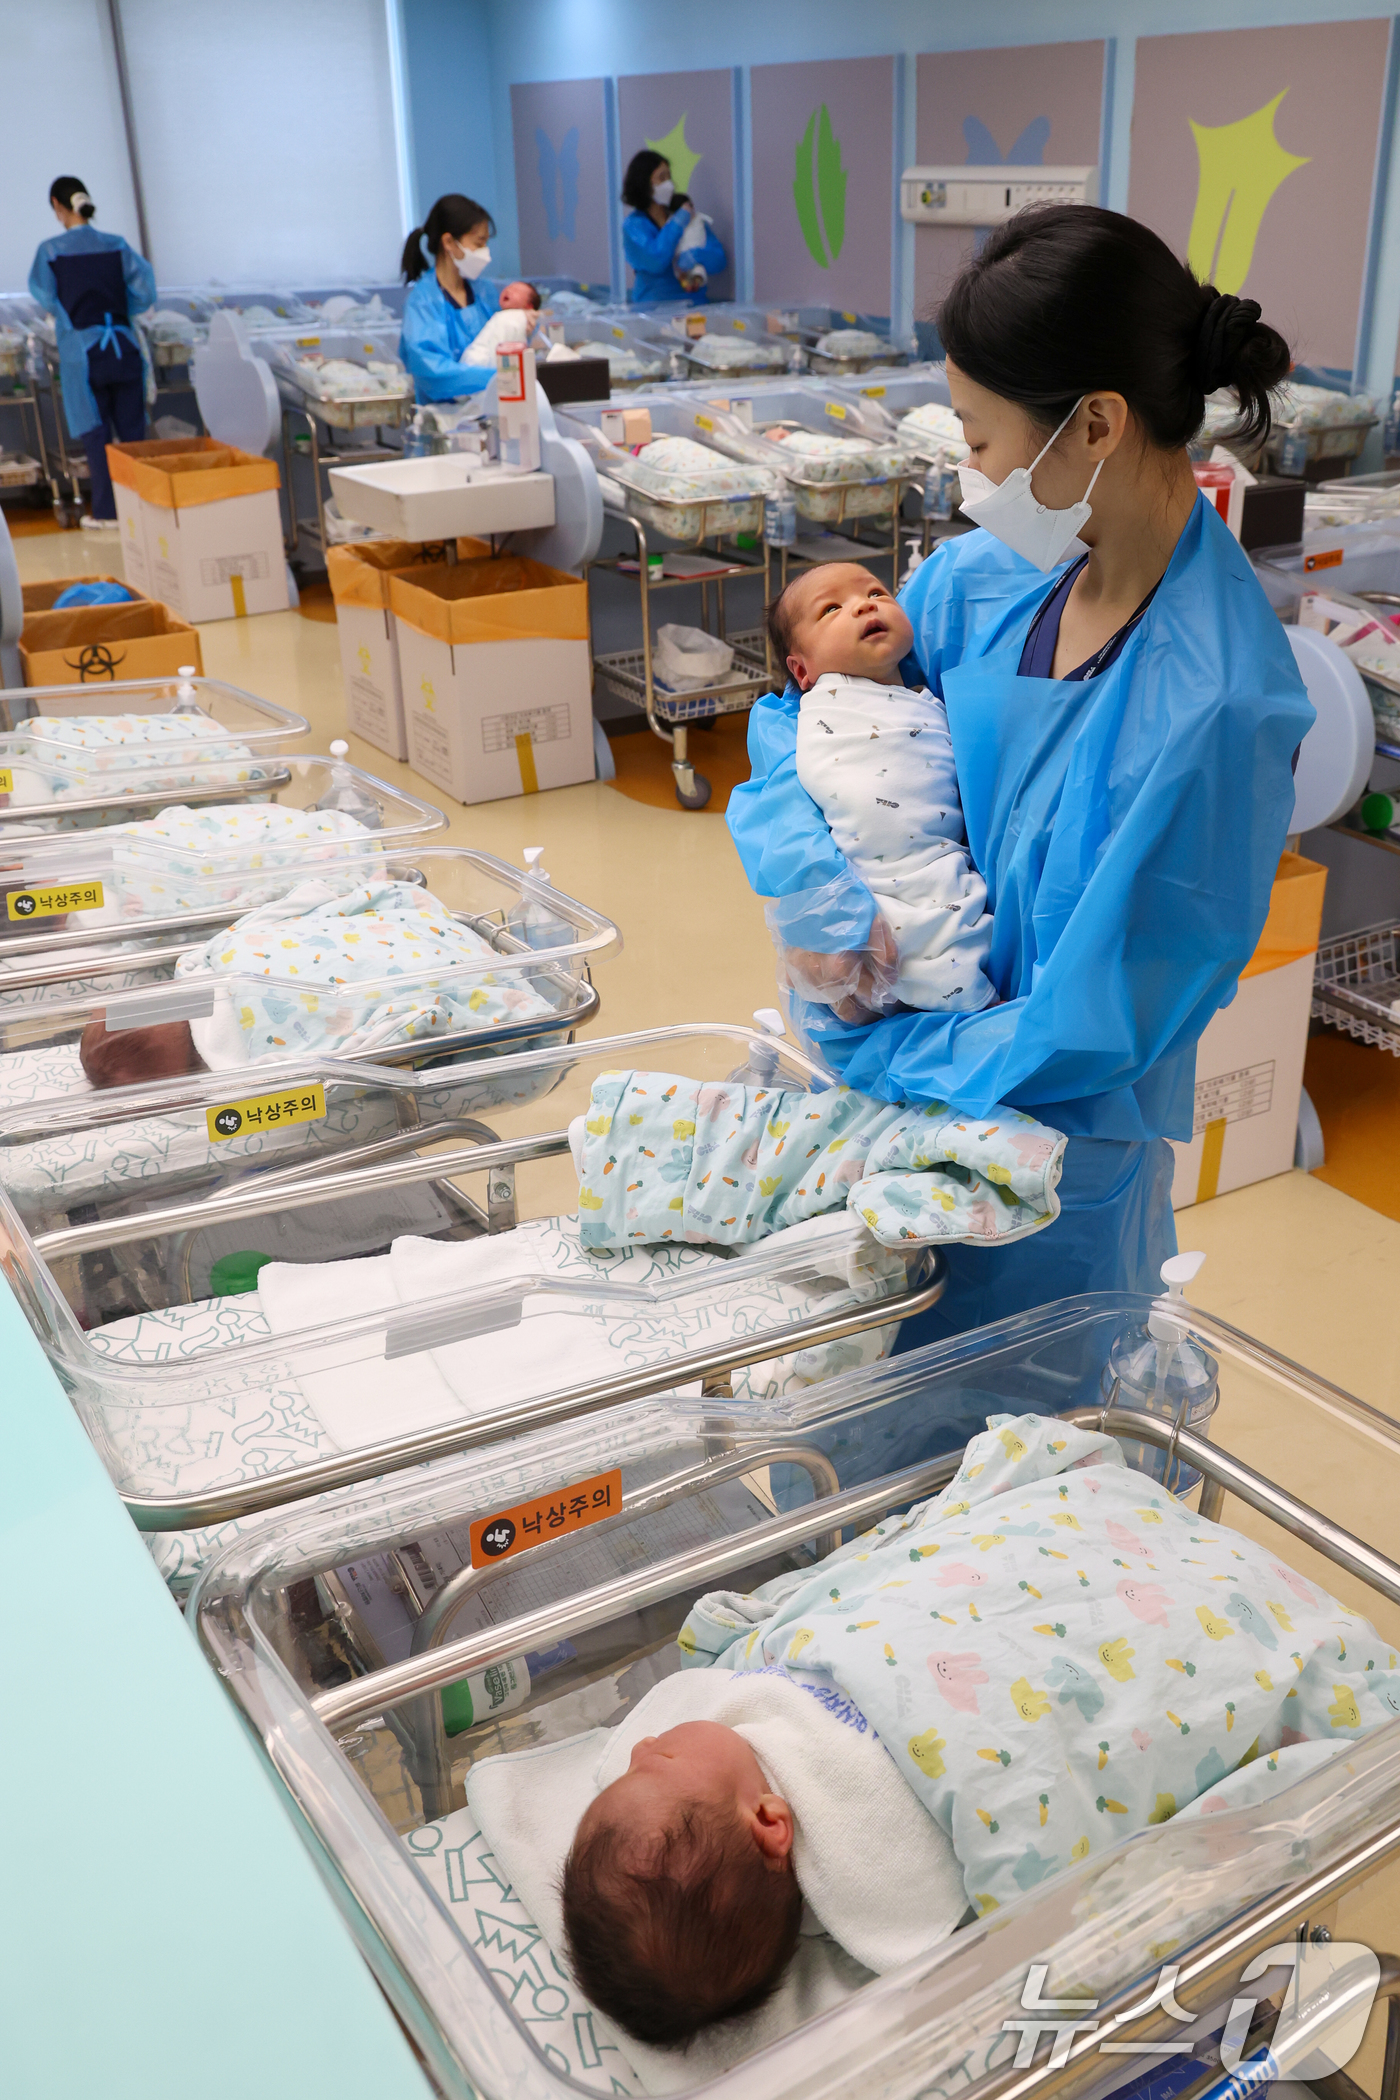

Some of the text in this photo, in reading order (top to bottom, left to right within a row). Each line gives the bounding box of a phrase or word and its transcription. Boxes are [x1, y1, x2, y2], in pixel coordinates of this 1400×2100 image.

[40, 889, 97, 909] 낙상주의
[246, 1094, 316, 1124] 낙상주의
[522, 1484, 611, 1534] 낙상주의
[489, 1667, 507, 1709] Vaseli
